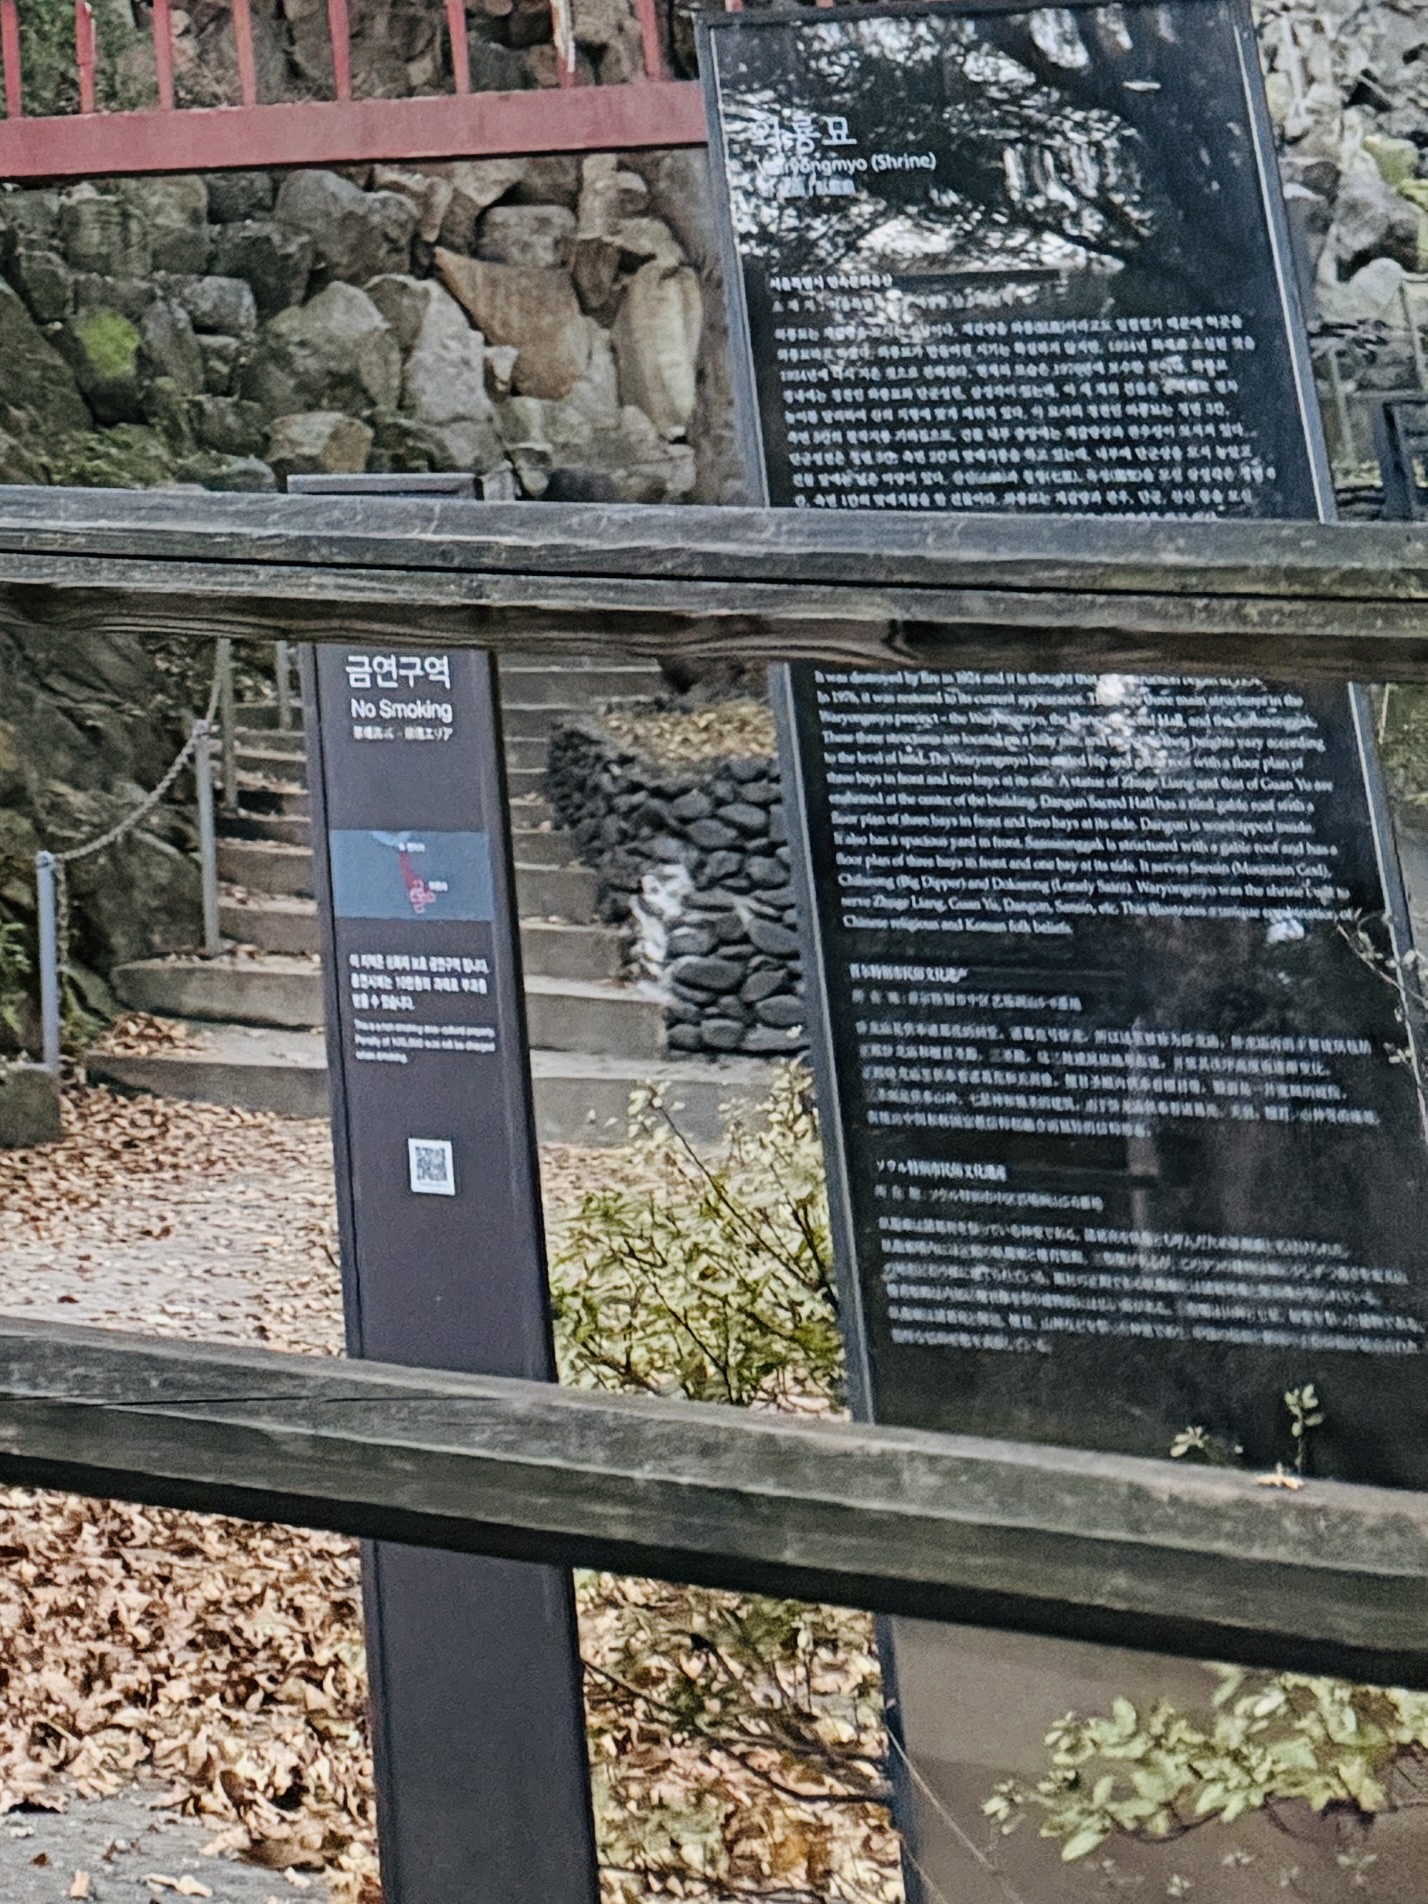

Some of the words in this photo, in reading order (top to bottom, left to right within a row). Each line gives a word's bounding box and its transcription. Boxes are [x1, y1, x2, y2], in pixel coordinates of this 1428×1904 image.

[871, 151, 937, 173] (Shrine)
[345, 654, 451, 690] 금연구역
[350, 698, 376, 719] No
[379, 698, 453, 724] Smoking
